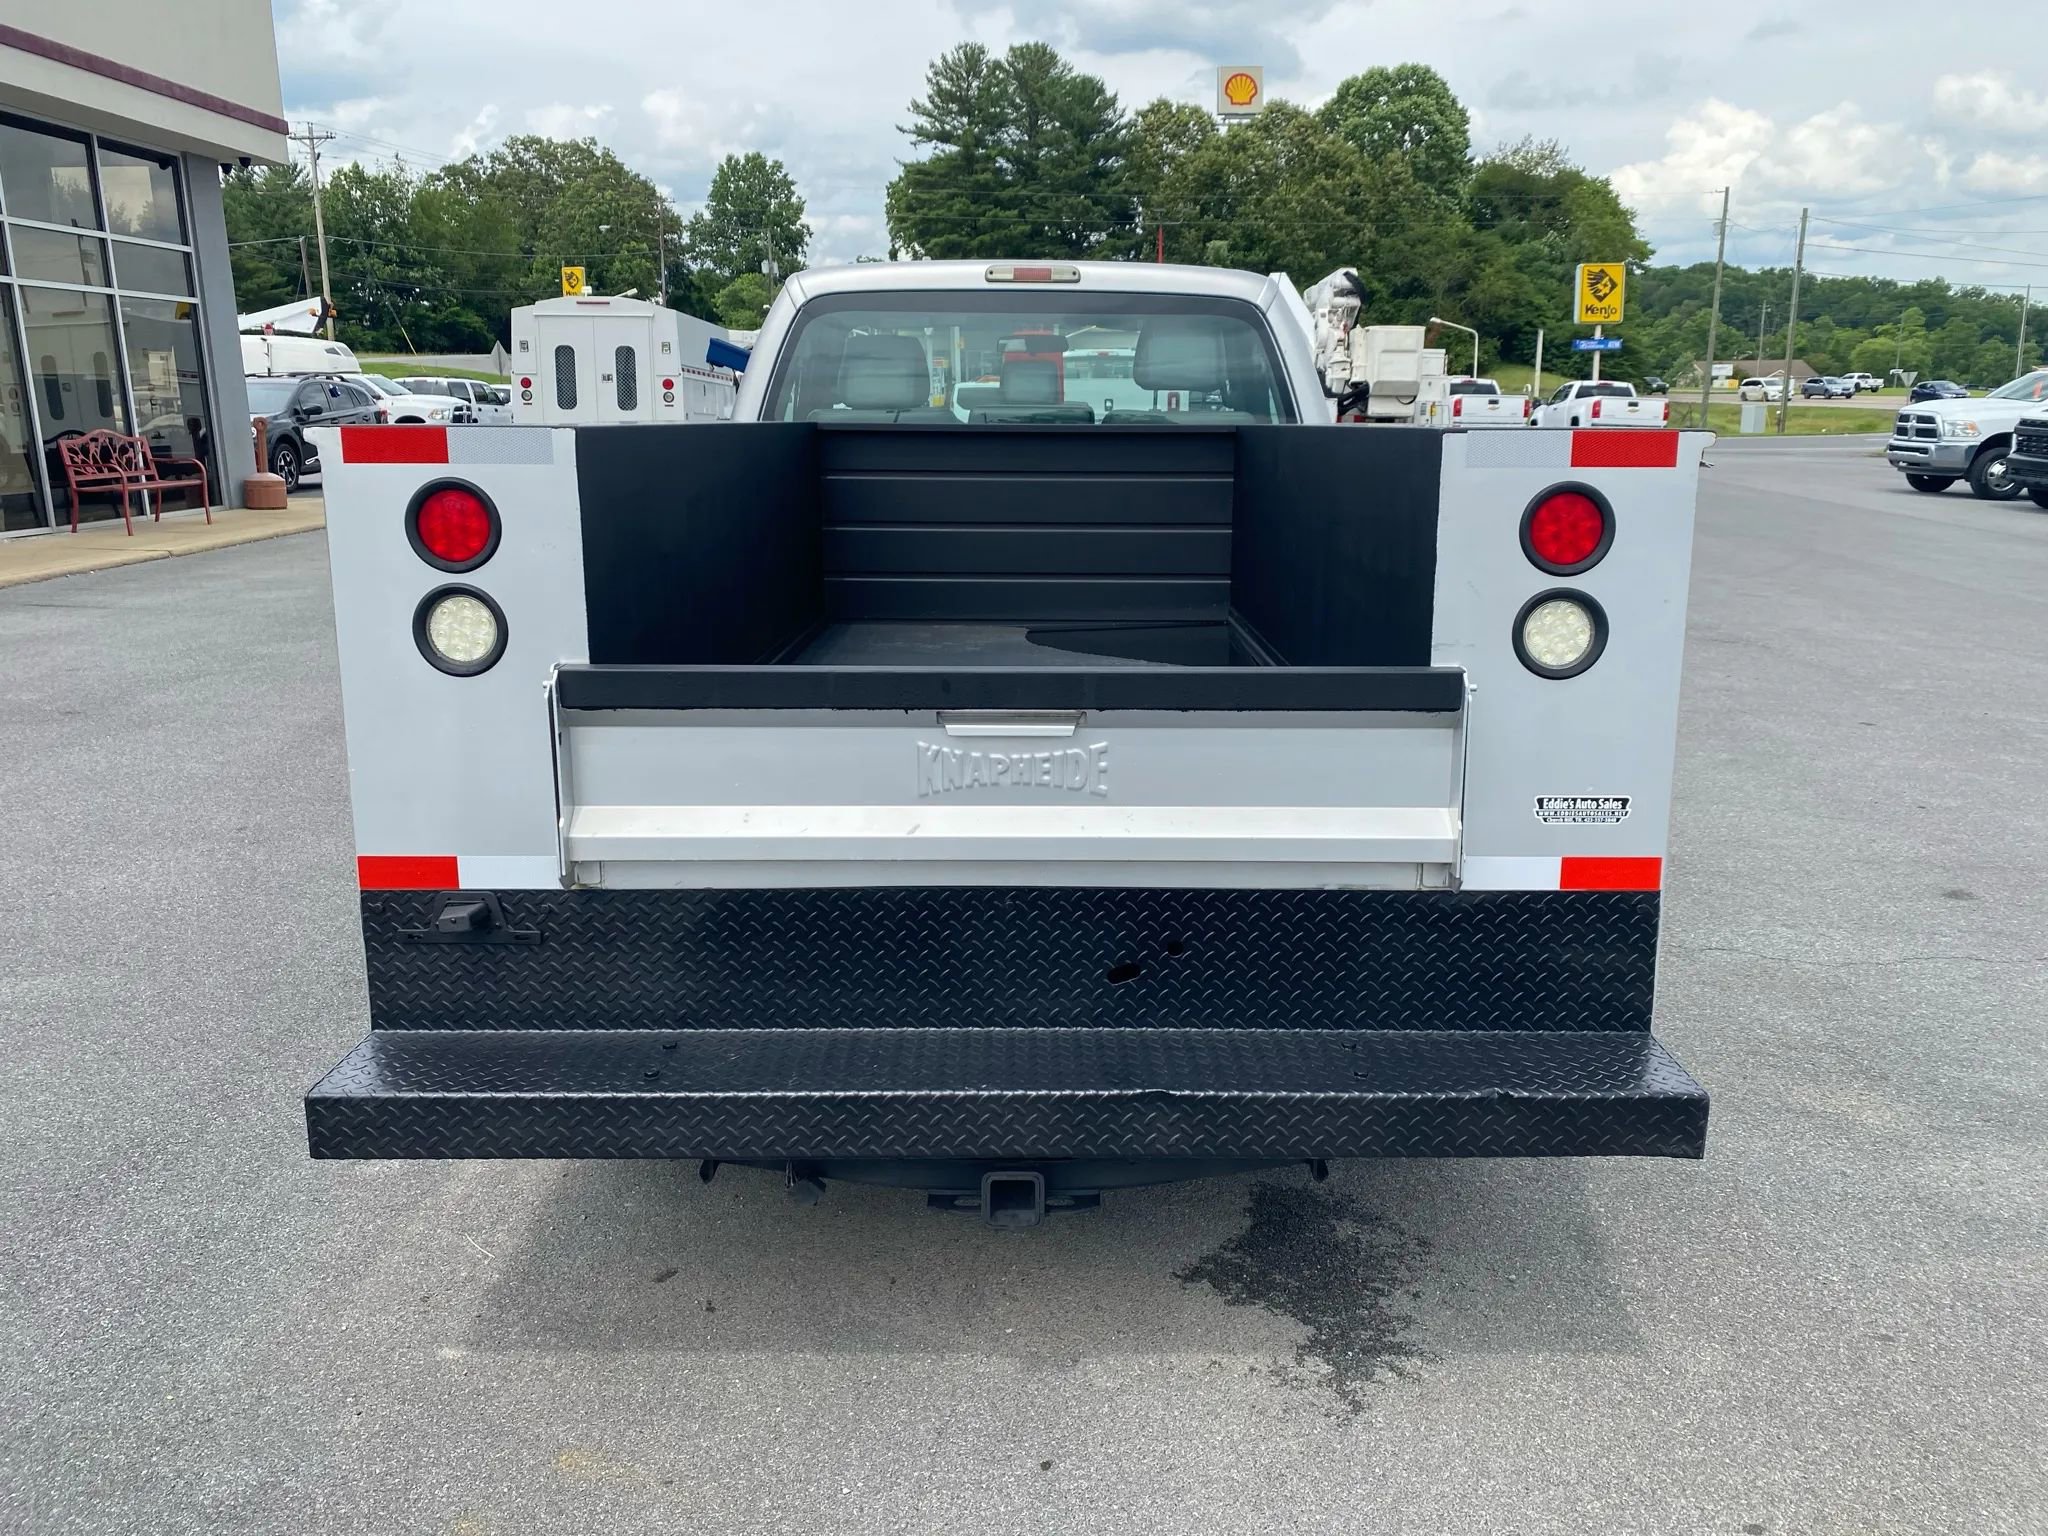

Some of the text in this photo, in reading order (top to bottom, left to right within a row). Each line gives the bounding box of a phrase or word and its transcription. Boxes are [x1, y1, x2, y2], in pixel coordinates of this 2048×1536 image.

[1585, 304, 1617, 319] Kenjo
[917, 740, 1109, 798] KNAPHEIDE
[1543, 798, 1623, 809] Eddie's Auto Sales
